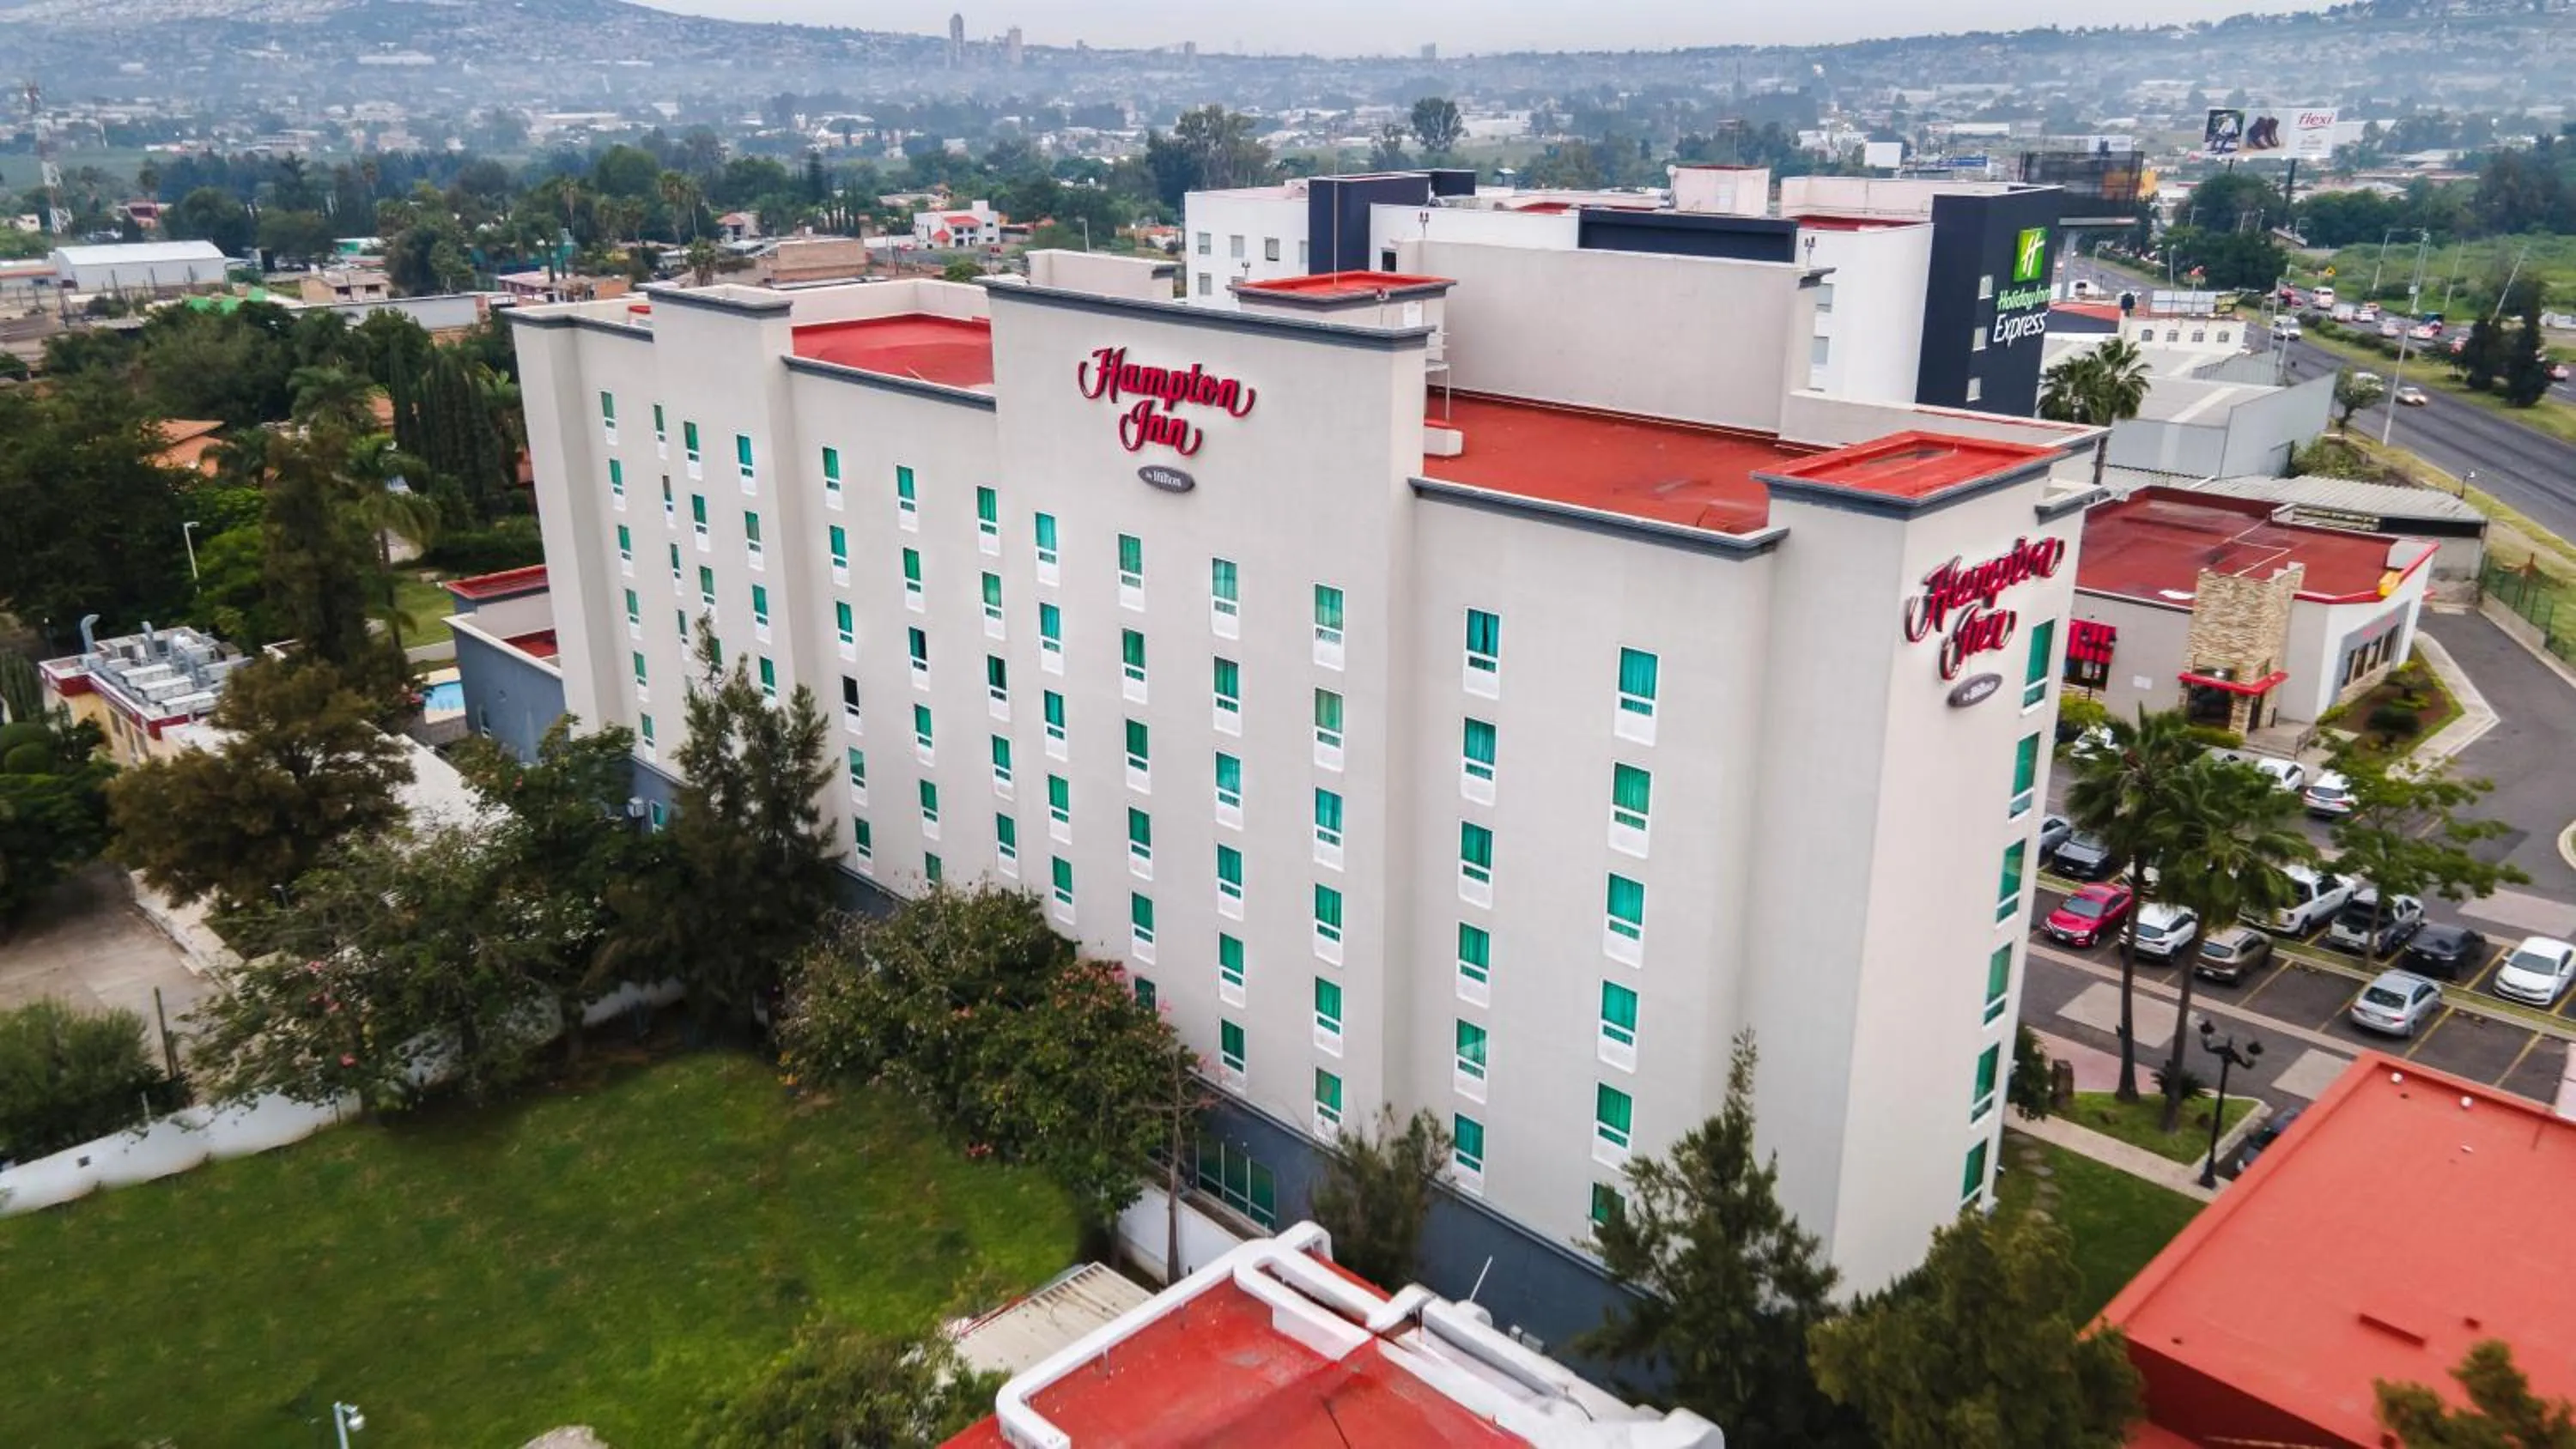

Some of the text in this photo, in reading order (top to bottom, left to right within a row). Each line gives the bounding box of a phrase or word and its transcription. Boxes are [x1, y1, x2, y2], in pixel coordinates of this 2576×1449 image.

[1993, 312, 2047, 348] Express
[1997, 287, 2035, 311] Holiday
[1078, 346, 1256, 418] Hampton
[1119, 399, 1202, 456] Inn
[1905, 535, 2064, 643] Hampton
[1938, 603, 2017, 681] Inn
